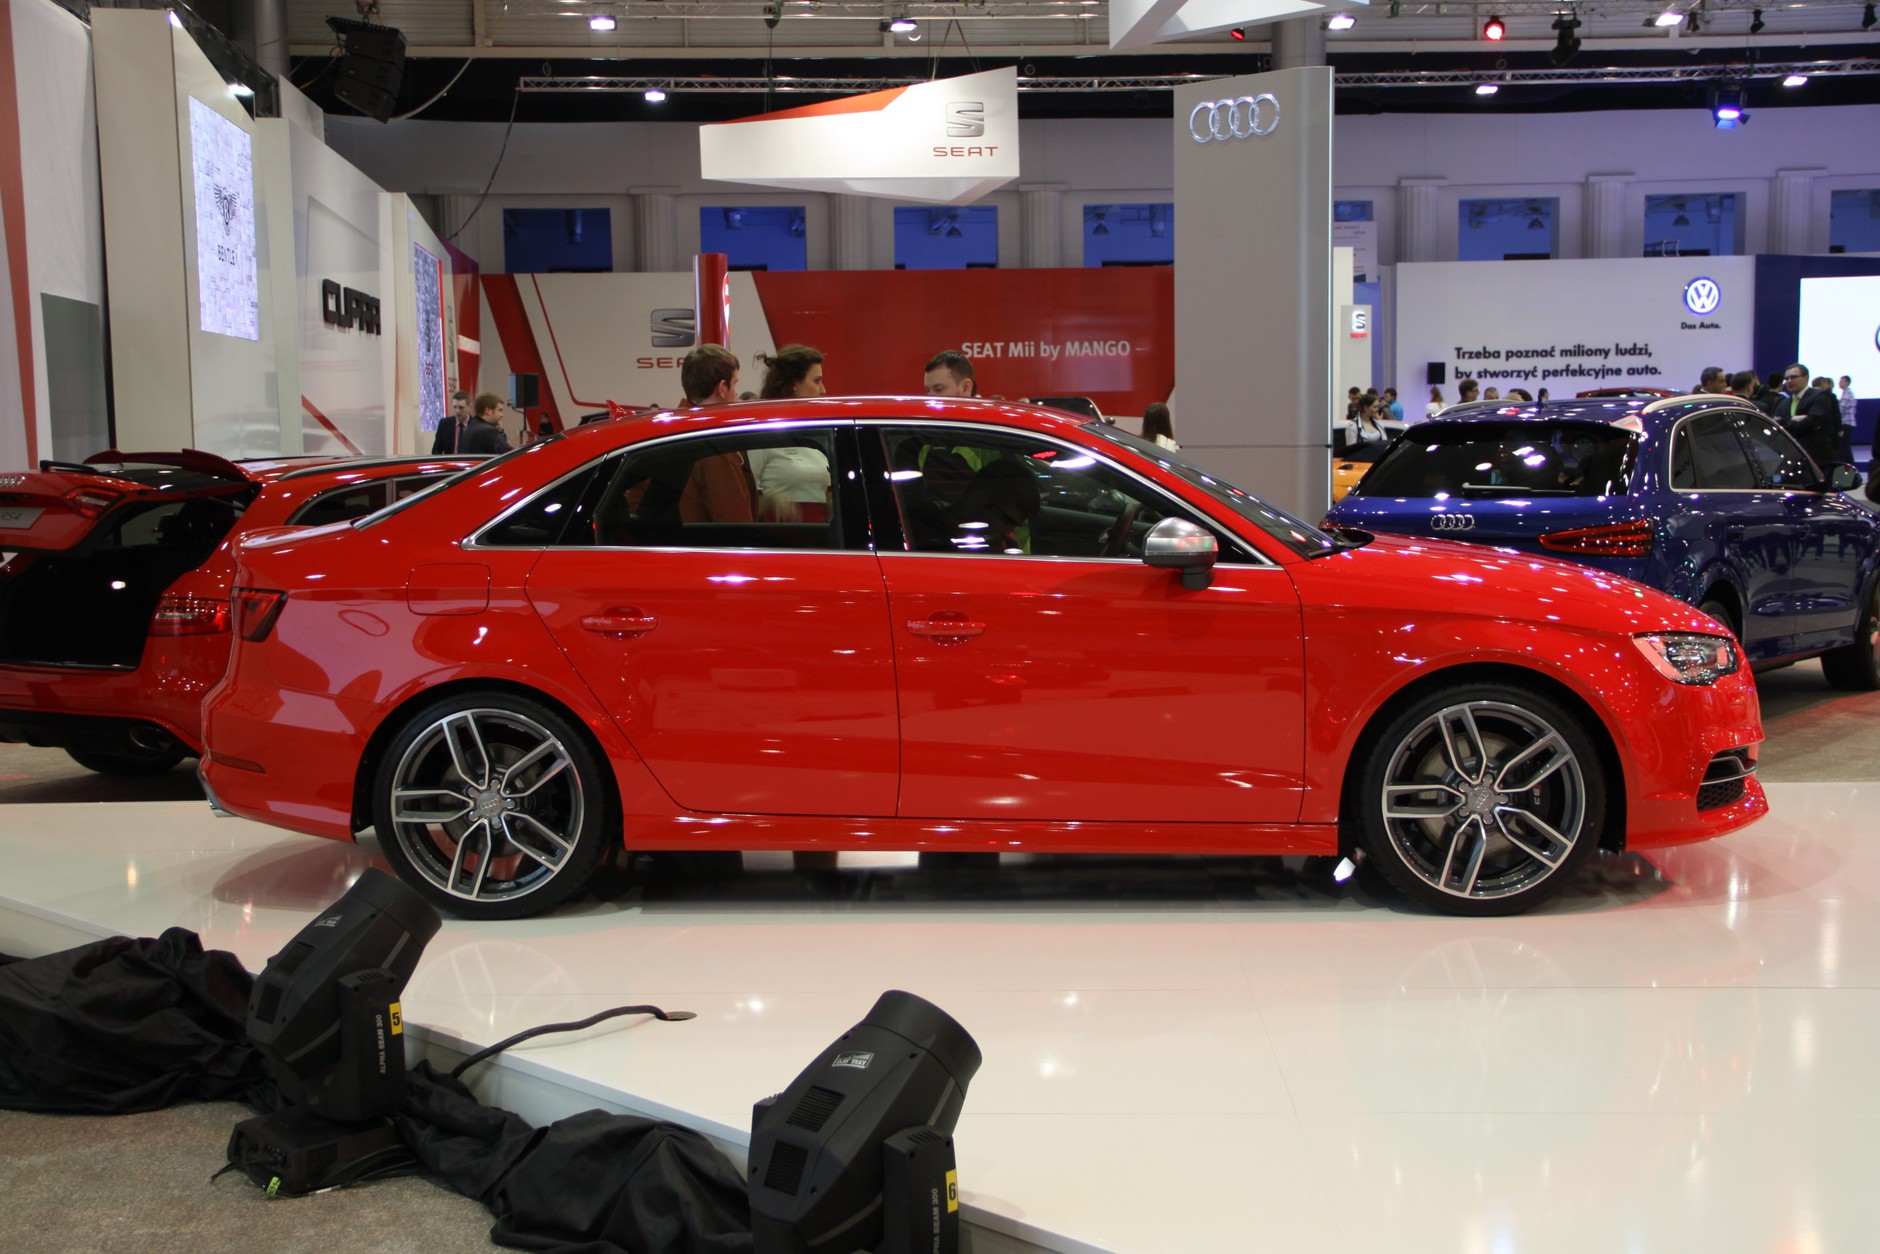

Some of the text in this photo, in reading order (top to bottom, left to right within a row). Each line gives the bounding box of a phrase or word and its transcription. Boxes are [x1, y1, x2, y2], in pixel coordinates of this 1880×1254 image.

[933, 147, 999, 157] SEAT
[322, 278, 382, 336] CUPRA
[1681, 321, 1721, 330] Das Auto.
[961, 340, 1131, 361] SEAT Mii by MANGO
[1454, 343, 1653, 362] Trzeba poznać miliony ludzi,
[1476, 366, 1538, 381] stworzyć
[1542, 364, 1623, 380] perfekcyjne
[1626, 363, 1662, 377] auto.
[375, 1014, 383, 1028] 300
[392, 1012, 400, 1026] 5
[377, 1029, 385, 1049] BEAM
[931, 1187, 939, 1205] 300
[948, 1182, 957, 1201] 6
[932, 1206, 940, 1234] BEAM
